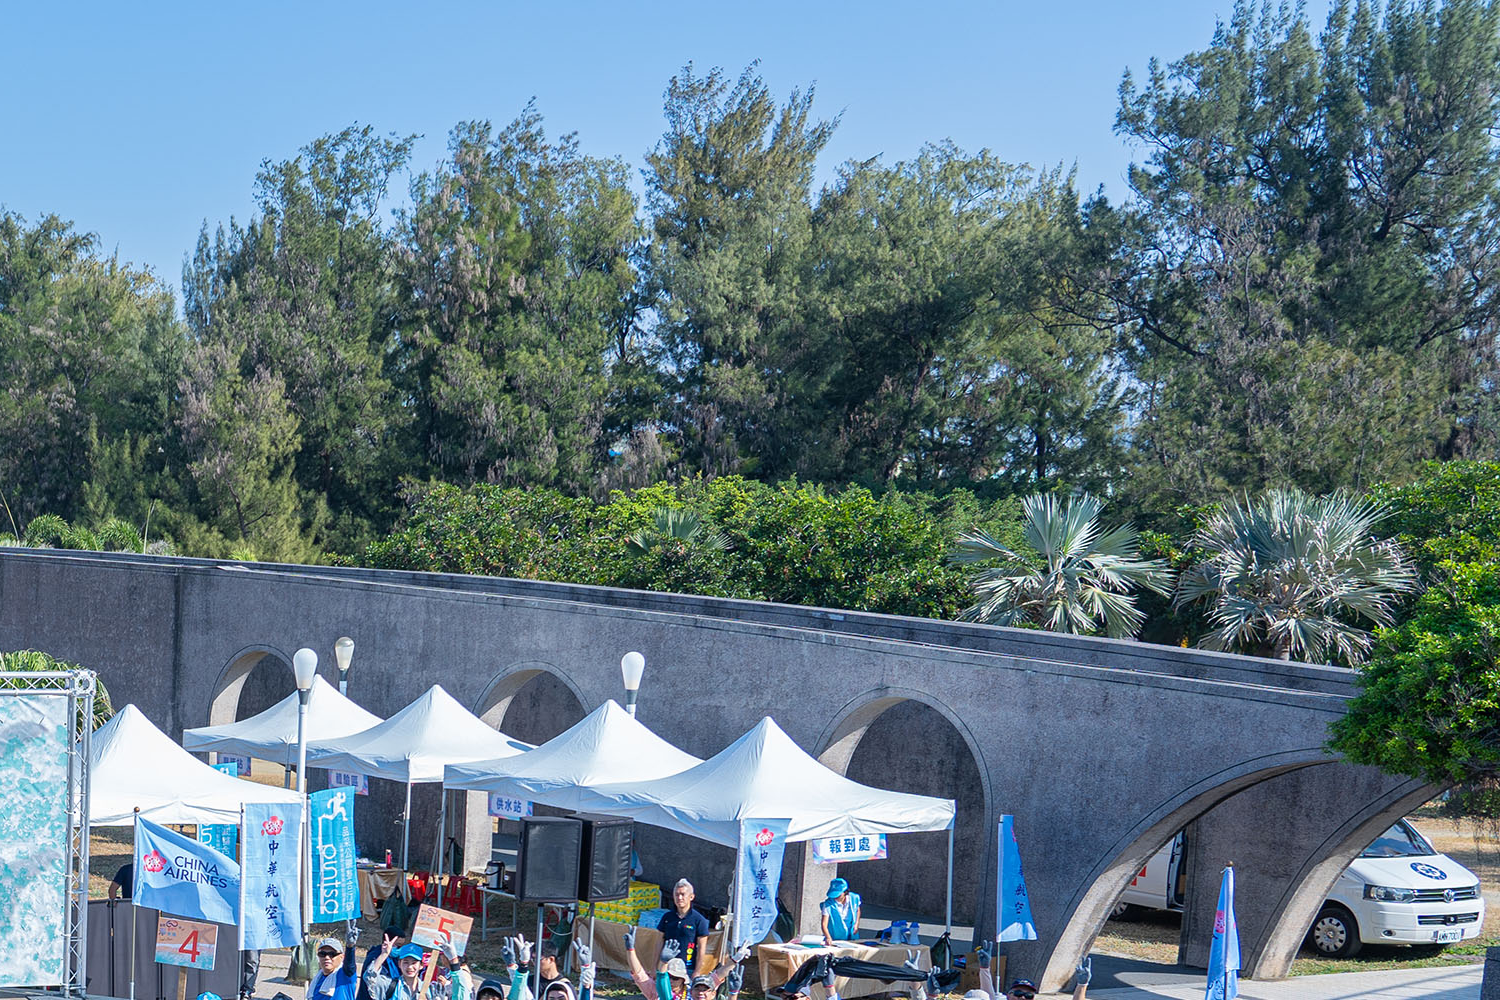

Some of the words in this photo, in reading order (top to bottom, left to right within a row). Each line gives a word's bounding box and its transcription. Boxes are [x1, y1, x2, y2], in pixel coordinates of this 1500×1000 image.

[496, 797, 522, 813] 供水站
[829, 836, 870, 854] 報到處
[164, 867, 228, 888] AIRLINES
[174, 856, 219, 876] CHINA
[264, 839, 280, 920] 中華航空
[751, 849, 769, 919] 中華航空
[434, 917, 454, 945] 5
[178, 930, 200, 963] 4
